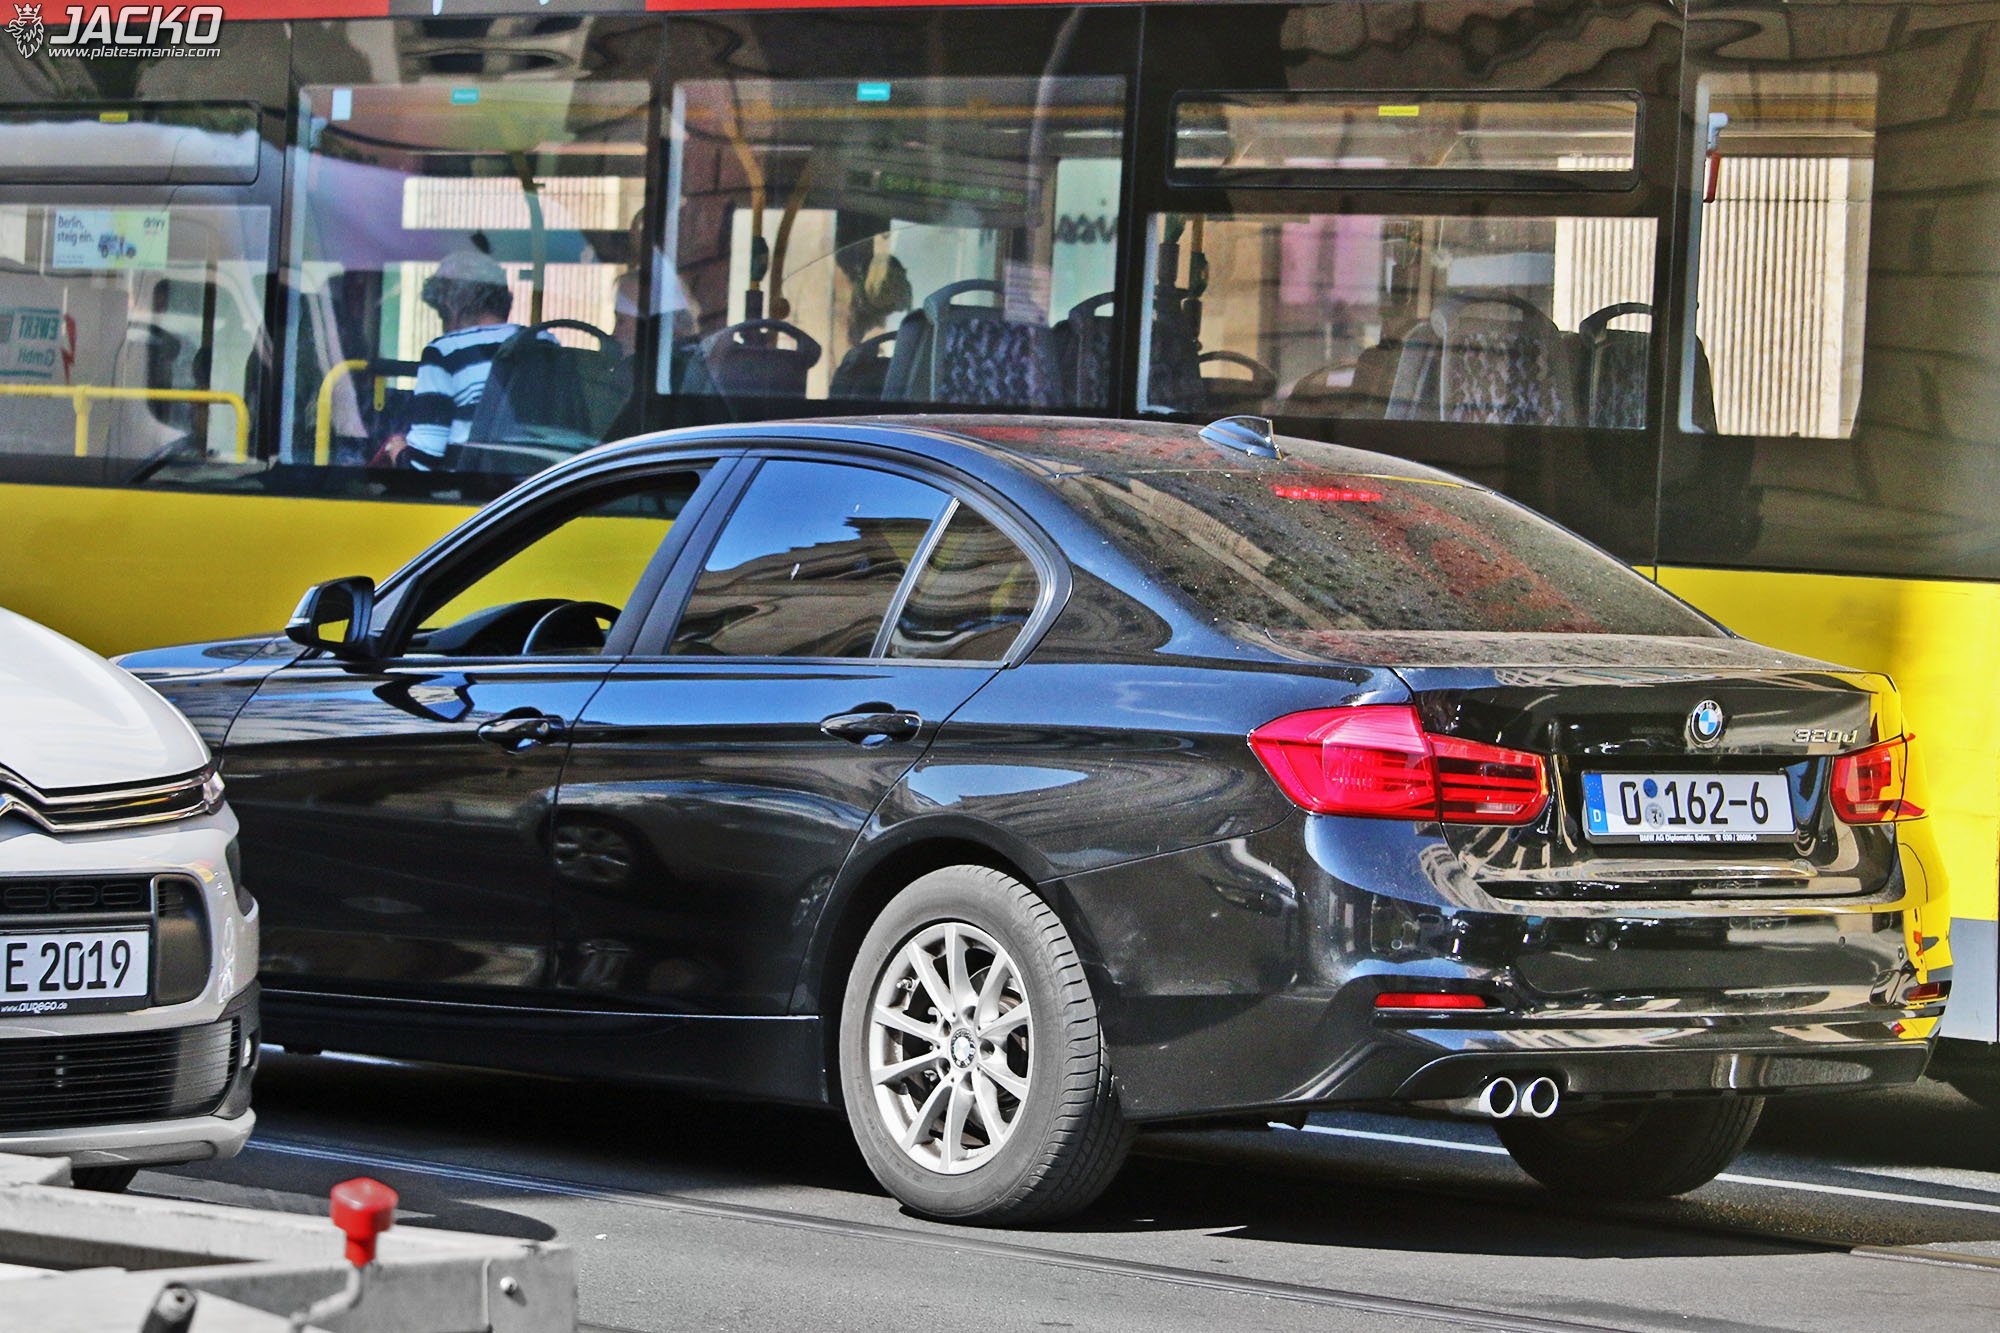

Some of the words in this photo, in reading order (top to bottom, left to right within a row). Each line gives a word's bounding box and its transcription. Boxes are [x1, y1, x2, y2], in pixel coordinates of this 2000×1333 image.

[58, 215, 84, 229] Berlin,
[57, 232, 77, 246] steig
[1793, 729, 1857, 743] 320d
[1593, 808, 1602, 823] D
[1664, 781, 1769, 825] 162-6
[6, 942, 29, 993] E
[39, 939, 131, 991] 2019
